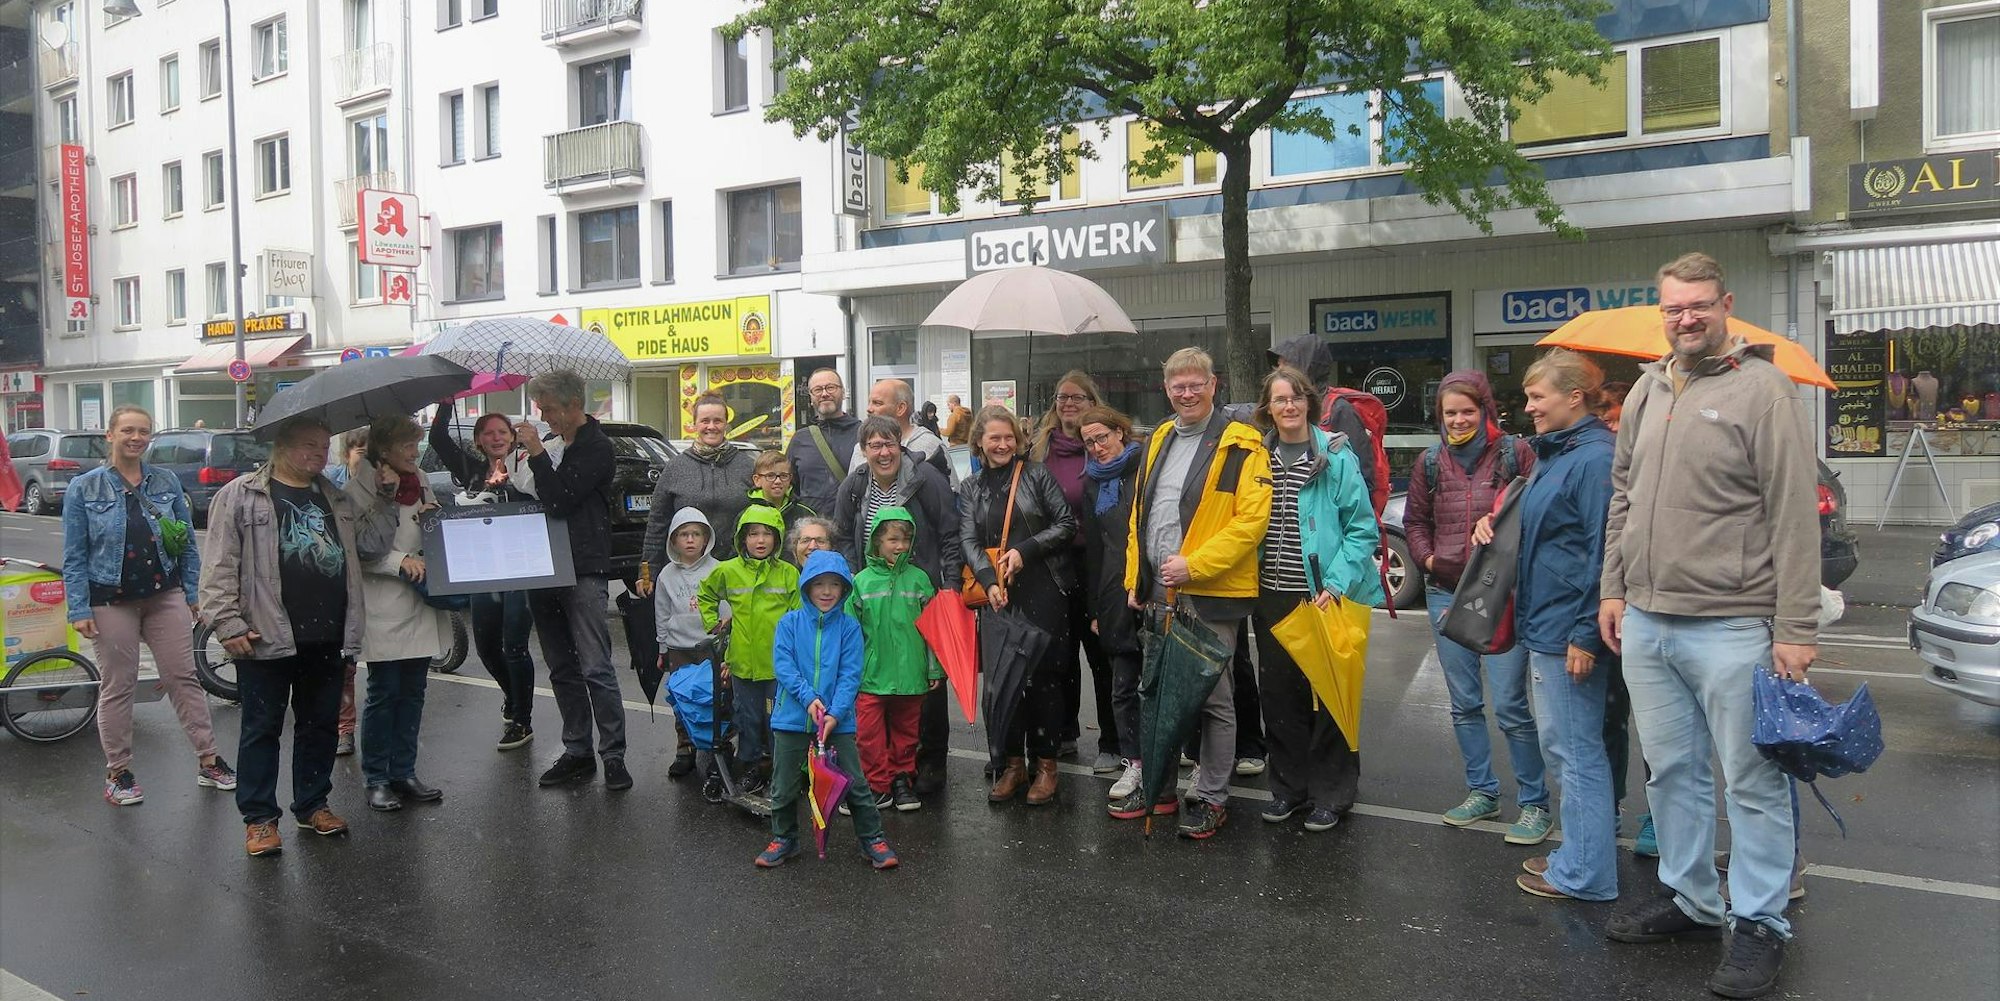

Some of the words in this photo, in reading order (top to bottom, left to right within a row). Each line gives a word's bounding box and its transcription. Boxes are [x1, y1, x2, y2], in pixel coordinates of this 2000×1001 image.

[1908, 158, 1980, 193] AL
[69, 150, 83, 270] JOSEF-APOTHEKE
[1868, 199, 1902, 208] JEWELRY
[375, 247, 415, 256] APOTHEKE
[271, 253, 308, 270] Frisuren
[273, 269, 306, 293] Shop
[614, 310, 650, 330] ÇITIR
[654, 304, 732, 324] LAHMACUN
[207, 321, 236, 337] HAND
[244, 315, 285, 333] PRAXIS
[667, 324, 677, 337] &
[637, 339, 667, 355] PIDE
[672, 336, 709, 354] HAUS
[1848, 352, 1865, 361] AL
[1831, 363, 1882, 374] KHALED
[1371, 385, 1397, 395] VIELFALT
